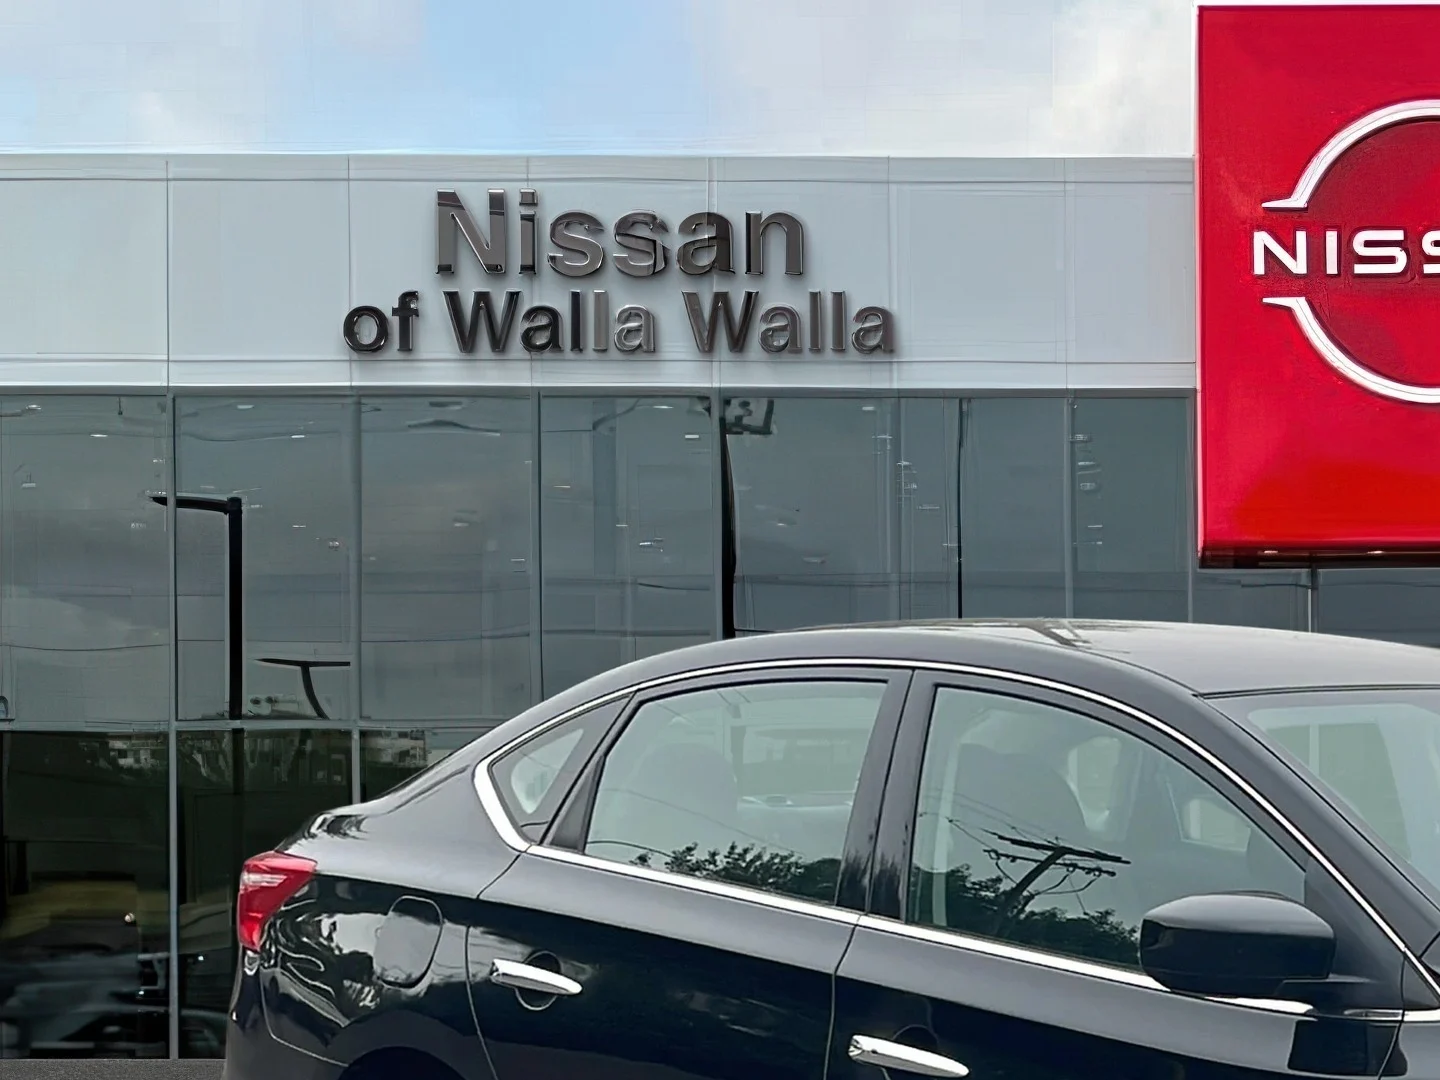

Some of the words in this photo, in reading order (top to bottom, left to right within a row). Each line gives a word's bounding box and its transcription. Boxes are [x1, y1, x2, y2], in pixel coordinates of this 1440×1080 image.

[434, 187, 805, 278] Nissan
[342, 289, 419, 354] of
[443, 289, 656, 354] Walla
[681, 289, 895, 354] Walla
